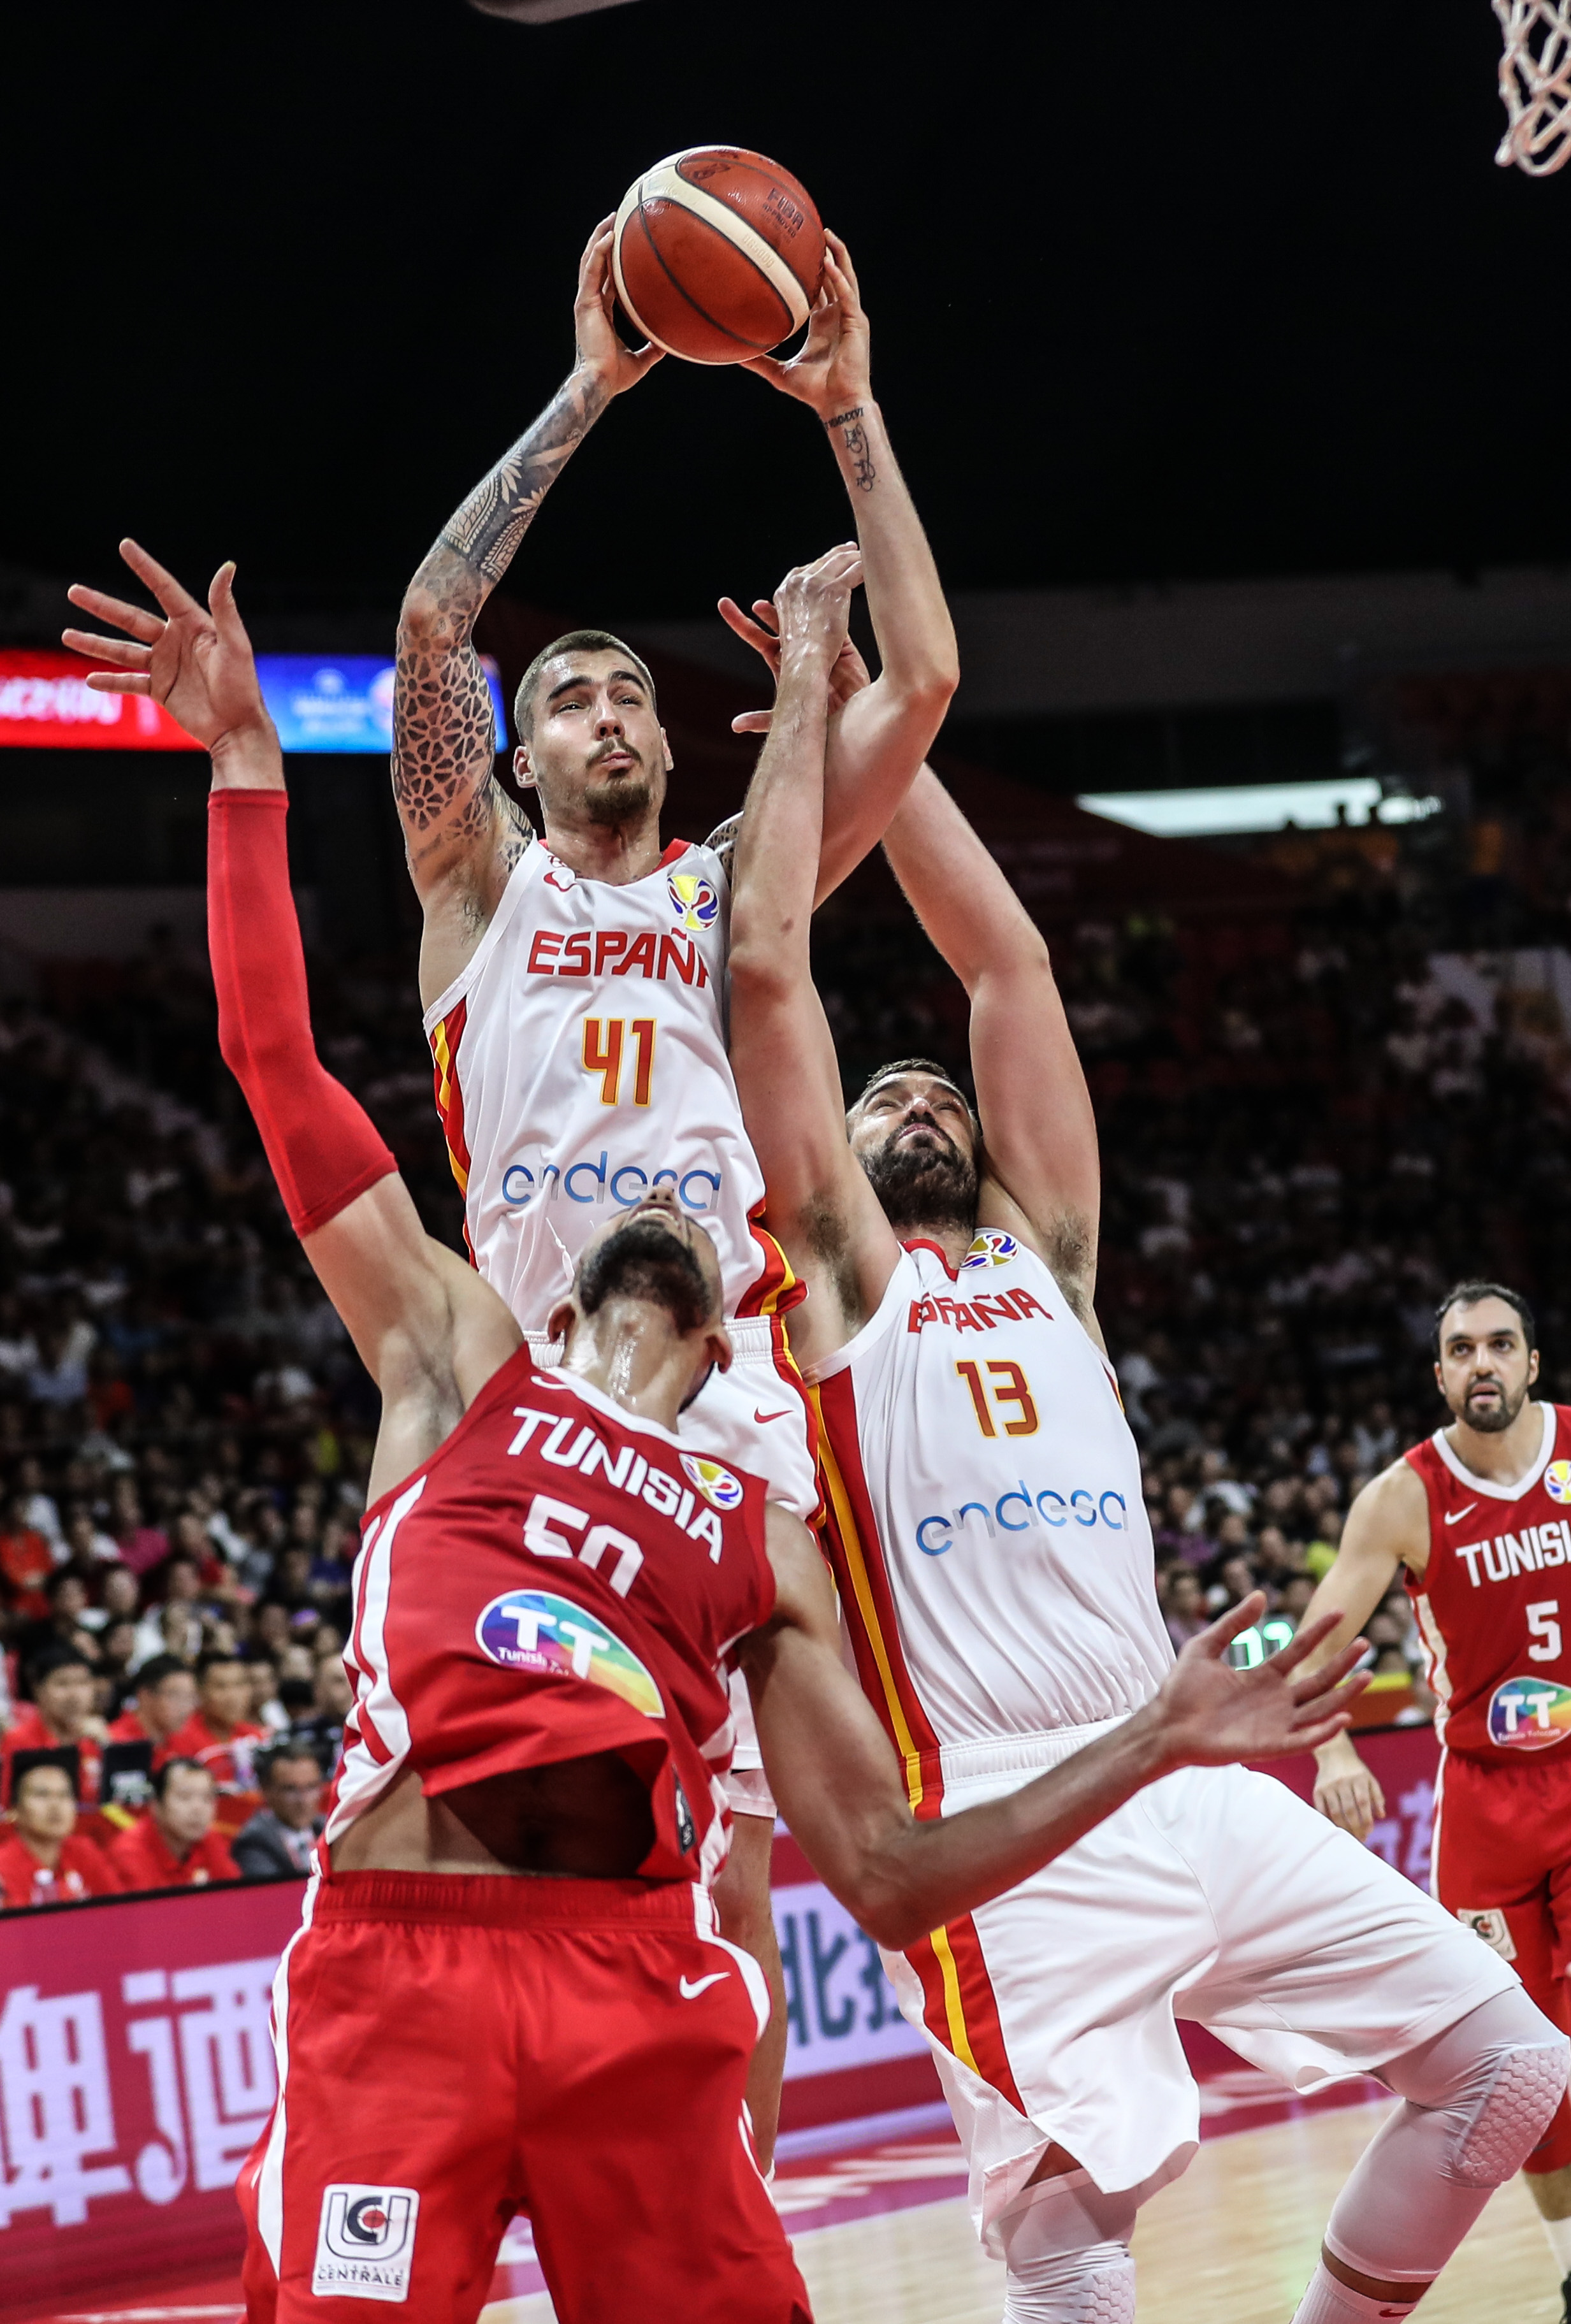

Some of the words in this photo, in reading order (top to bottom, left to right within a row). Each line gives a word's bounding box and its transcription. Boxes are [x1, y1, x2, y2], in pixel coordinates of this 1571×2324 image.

[767, 187, 804, 230] FIBA
[581, 1017, 657, 1108] 41
[955, 1359, 1040, 1439] 13
[507, 1406, 724, 1564] TUNISIA
[915, 1480, 1129, 1557] endesa
[500, 1605, 609, 1679] TT
[1526, 1599, 1562, 1663] 5
[1498, 1691, 1557, 1732] TT
